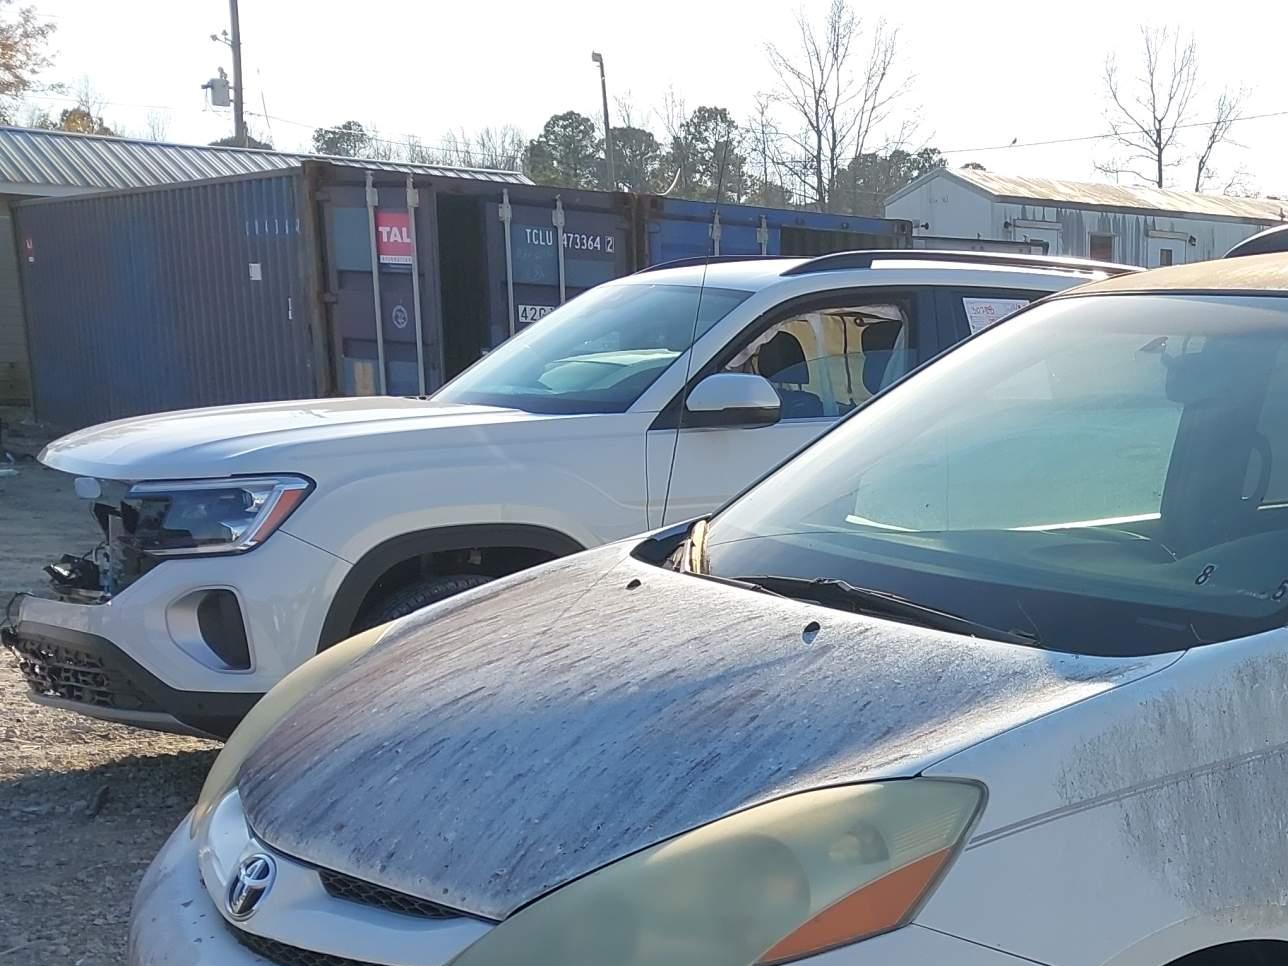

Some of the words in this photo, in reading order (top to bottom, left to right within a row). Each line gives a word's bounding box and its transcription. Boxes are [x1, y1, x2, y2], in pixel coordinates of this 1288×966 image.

[378, 226, 411, 243] TAL
[525, 228, 553, 246] TCLU
[606, 237, 614, 252] 2
[1194, 564, 1216, 585] 8
